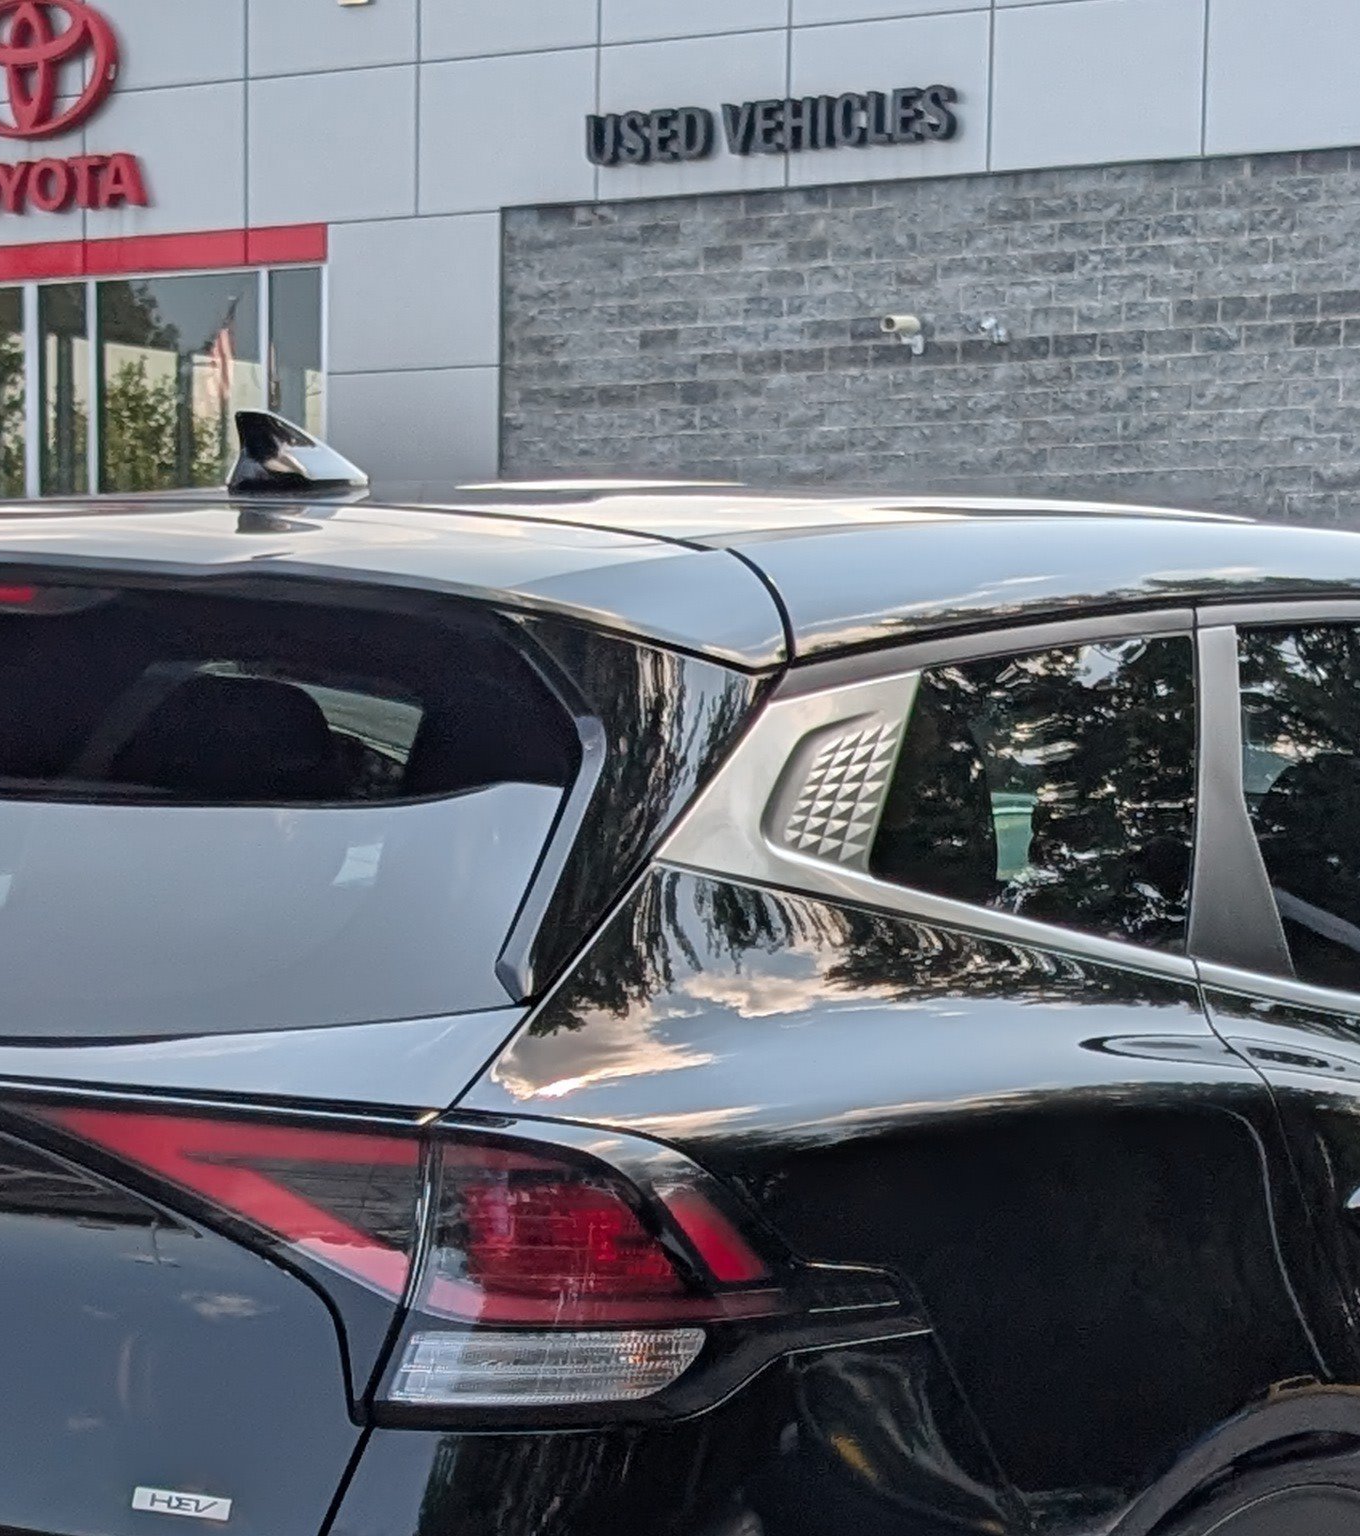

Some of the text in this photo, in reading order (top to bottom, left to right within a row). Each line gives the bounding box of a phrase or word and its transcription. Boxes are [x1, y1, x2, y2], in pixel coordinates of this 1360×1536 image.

[585, 84, 961, 167] USED VEHICLES
[149, 1492, 219, 1513] HEV
